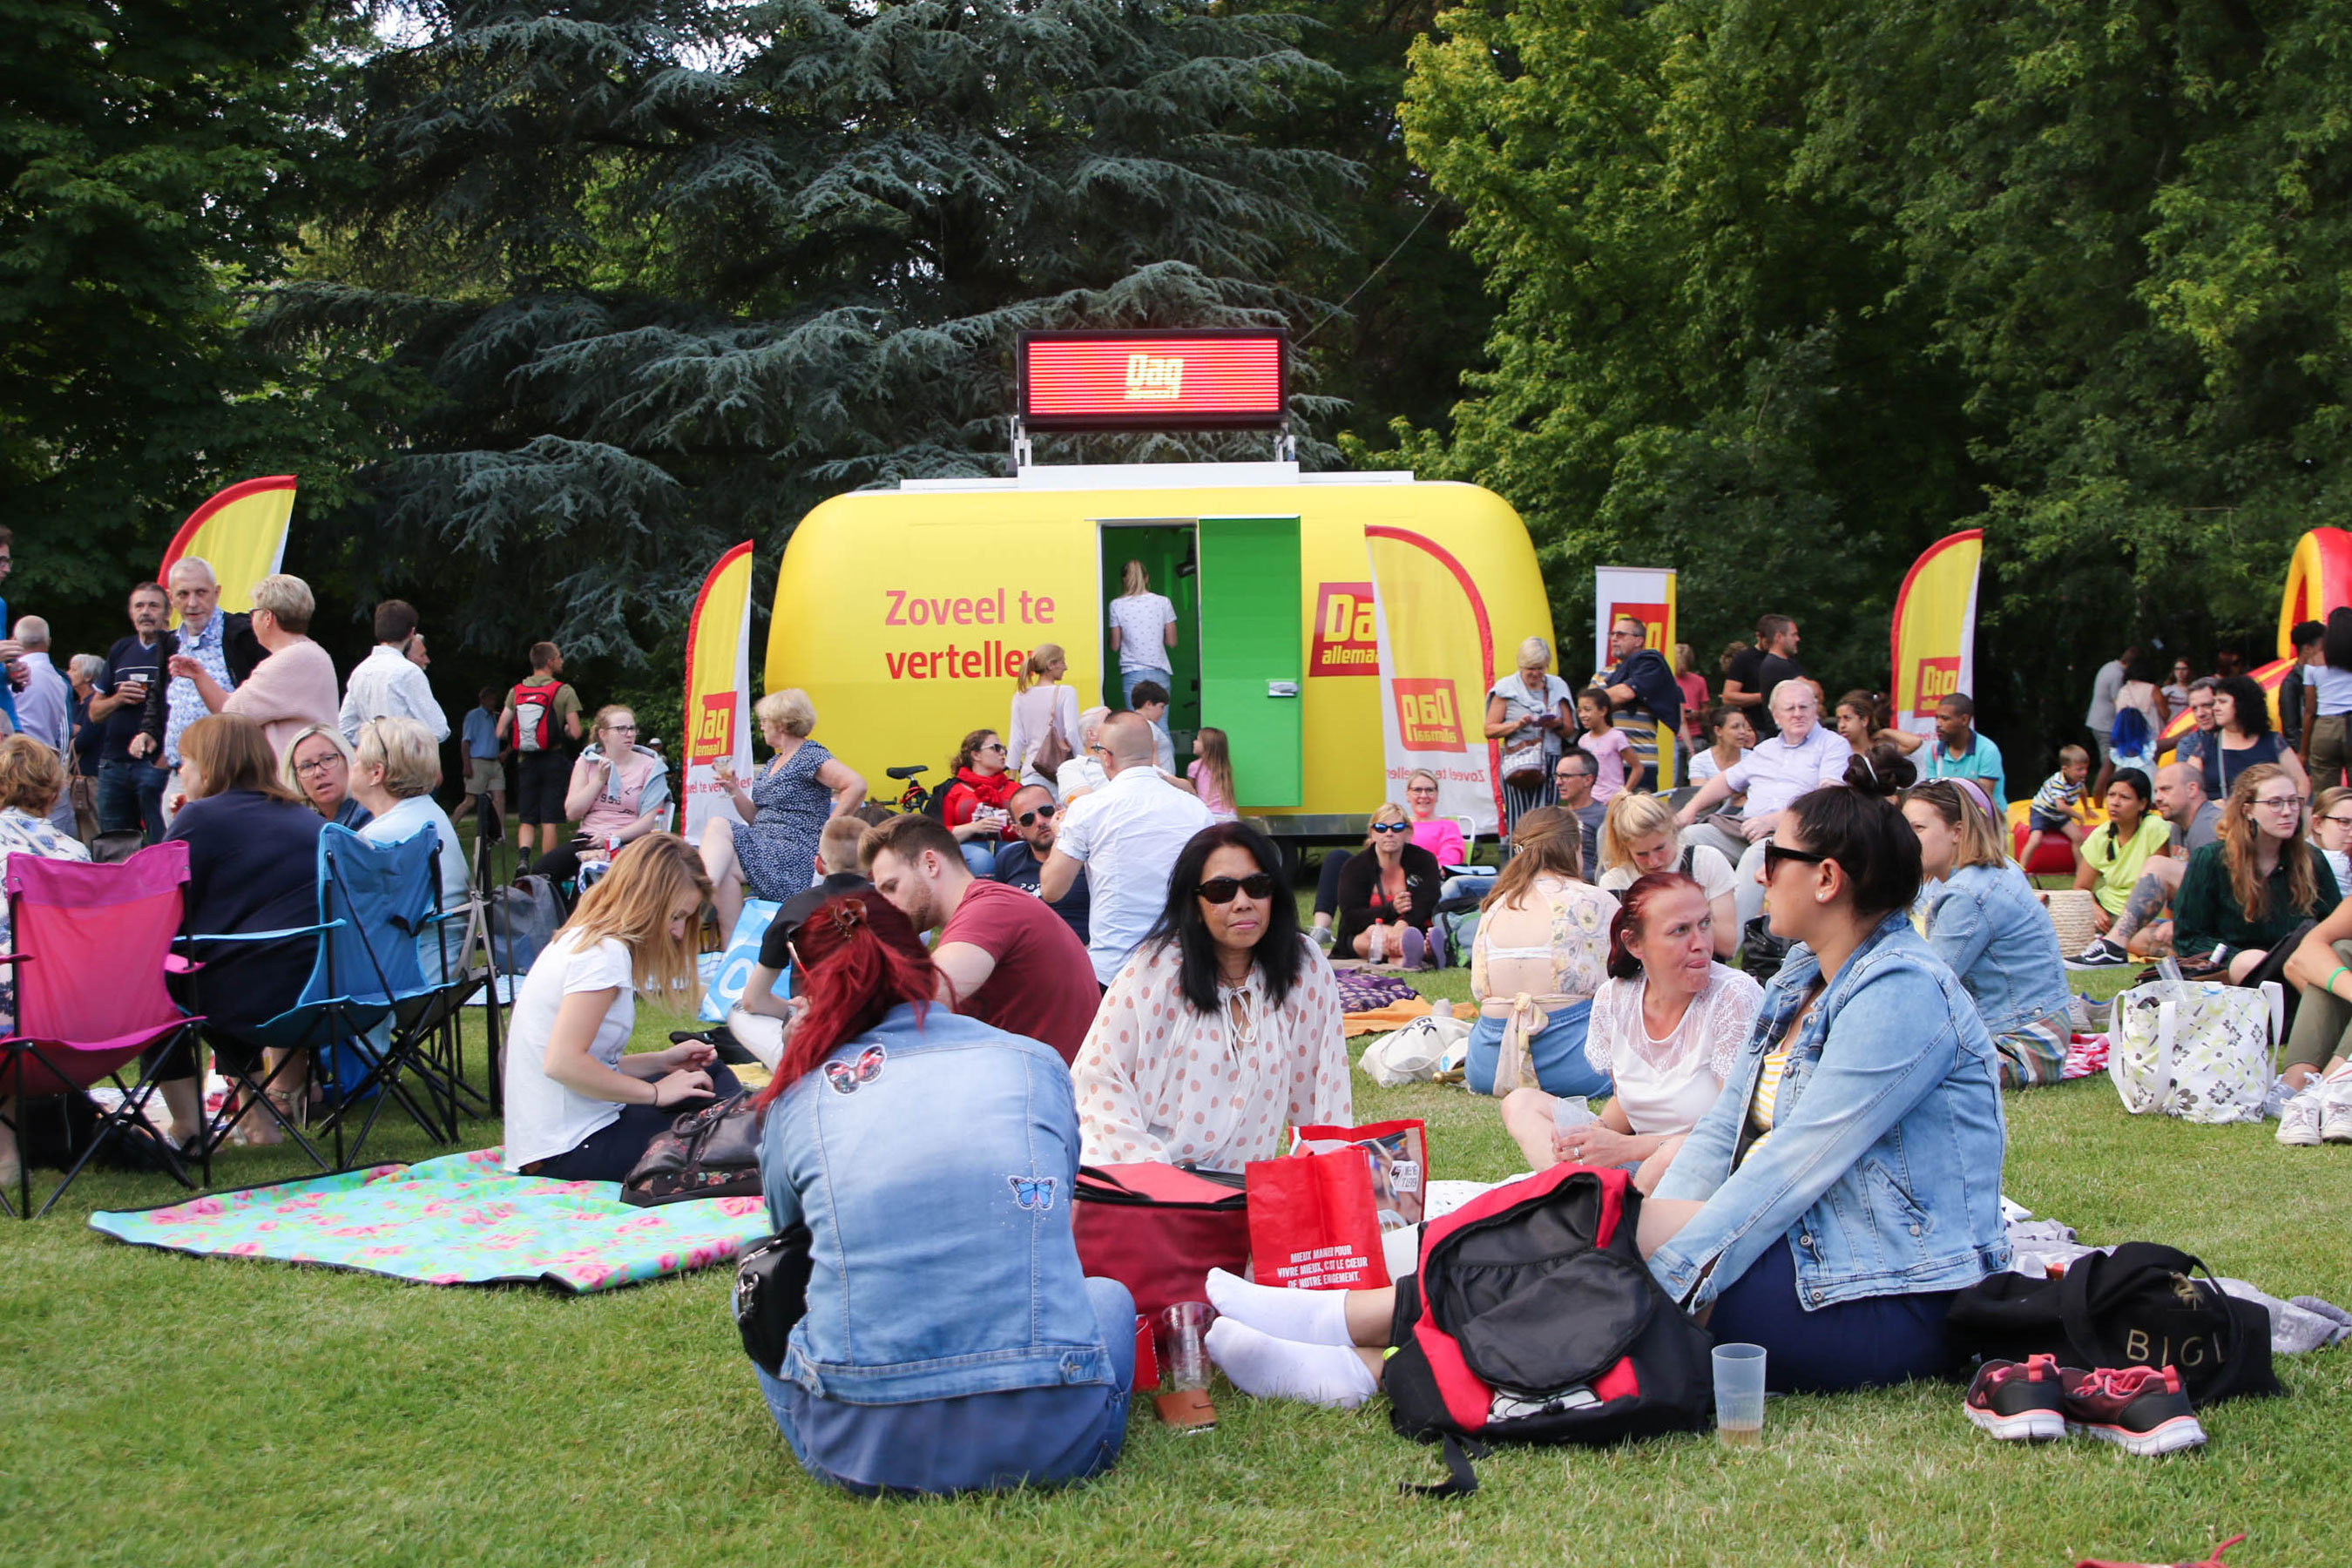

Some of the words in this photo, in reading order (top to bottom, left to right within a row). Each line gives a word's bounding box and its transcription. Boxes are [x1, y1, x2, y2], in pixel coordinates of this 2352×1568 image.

[885, 588, 1004, 625] Zoveel
[1018, 591, 1055, 625] te
[1323, 594, 1377, 643] Da
[885, 640, 1034, 679] vertelle
[1321, 645, 1379, 665] allema
[1290, 1250, 1312, 1263] MIEUX
[1335, 1245, 1352, 1256] POUR
[1276, 1266, 1299, 1278] VIVRE
[1337, 1259, 1344, 1270] LE
[1299, 1274, 1322, 1288] NOTRE
